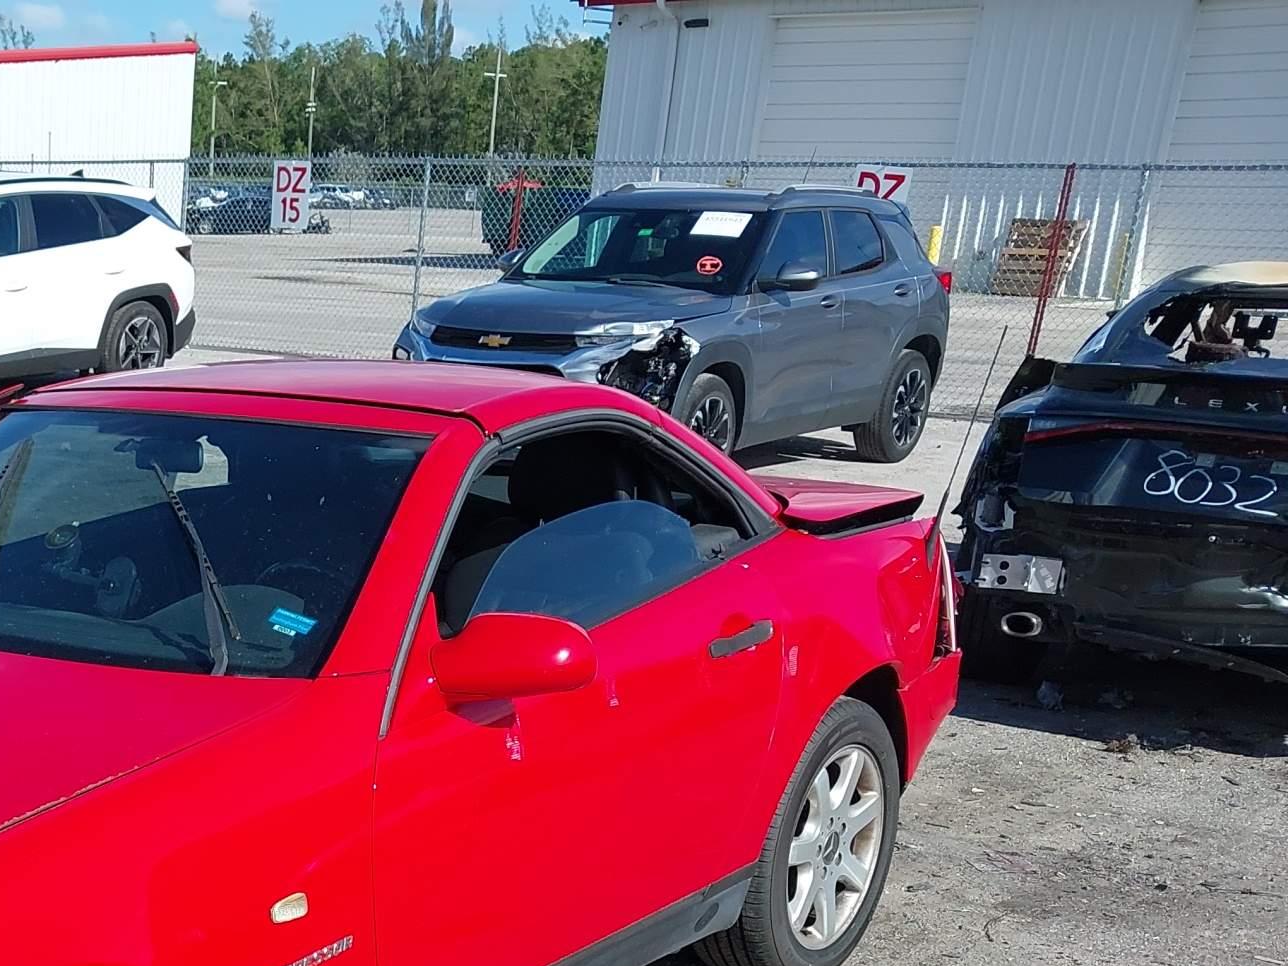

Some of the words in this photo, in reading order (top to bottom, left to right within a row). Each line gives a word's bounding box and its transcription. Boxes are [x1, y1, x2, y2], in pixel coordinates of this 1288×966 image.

[276, 166, 307, 193] DZ
[857, 171, 906, 199] DZ
[281, 197, 300, 223] 15
[1143, 449, 1279, 517] 8032
